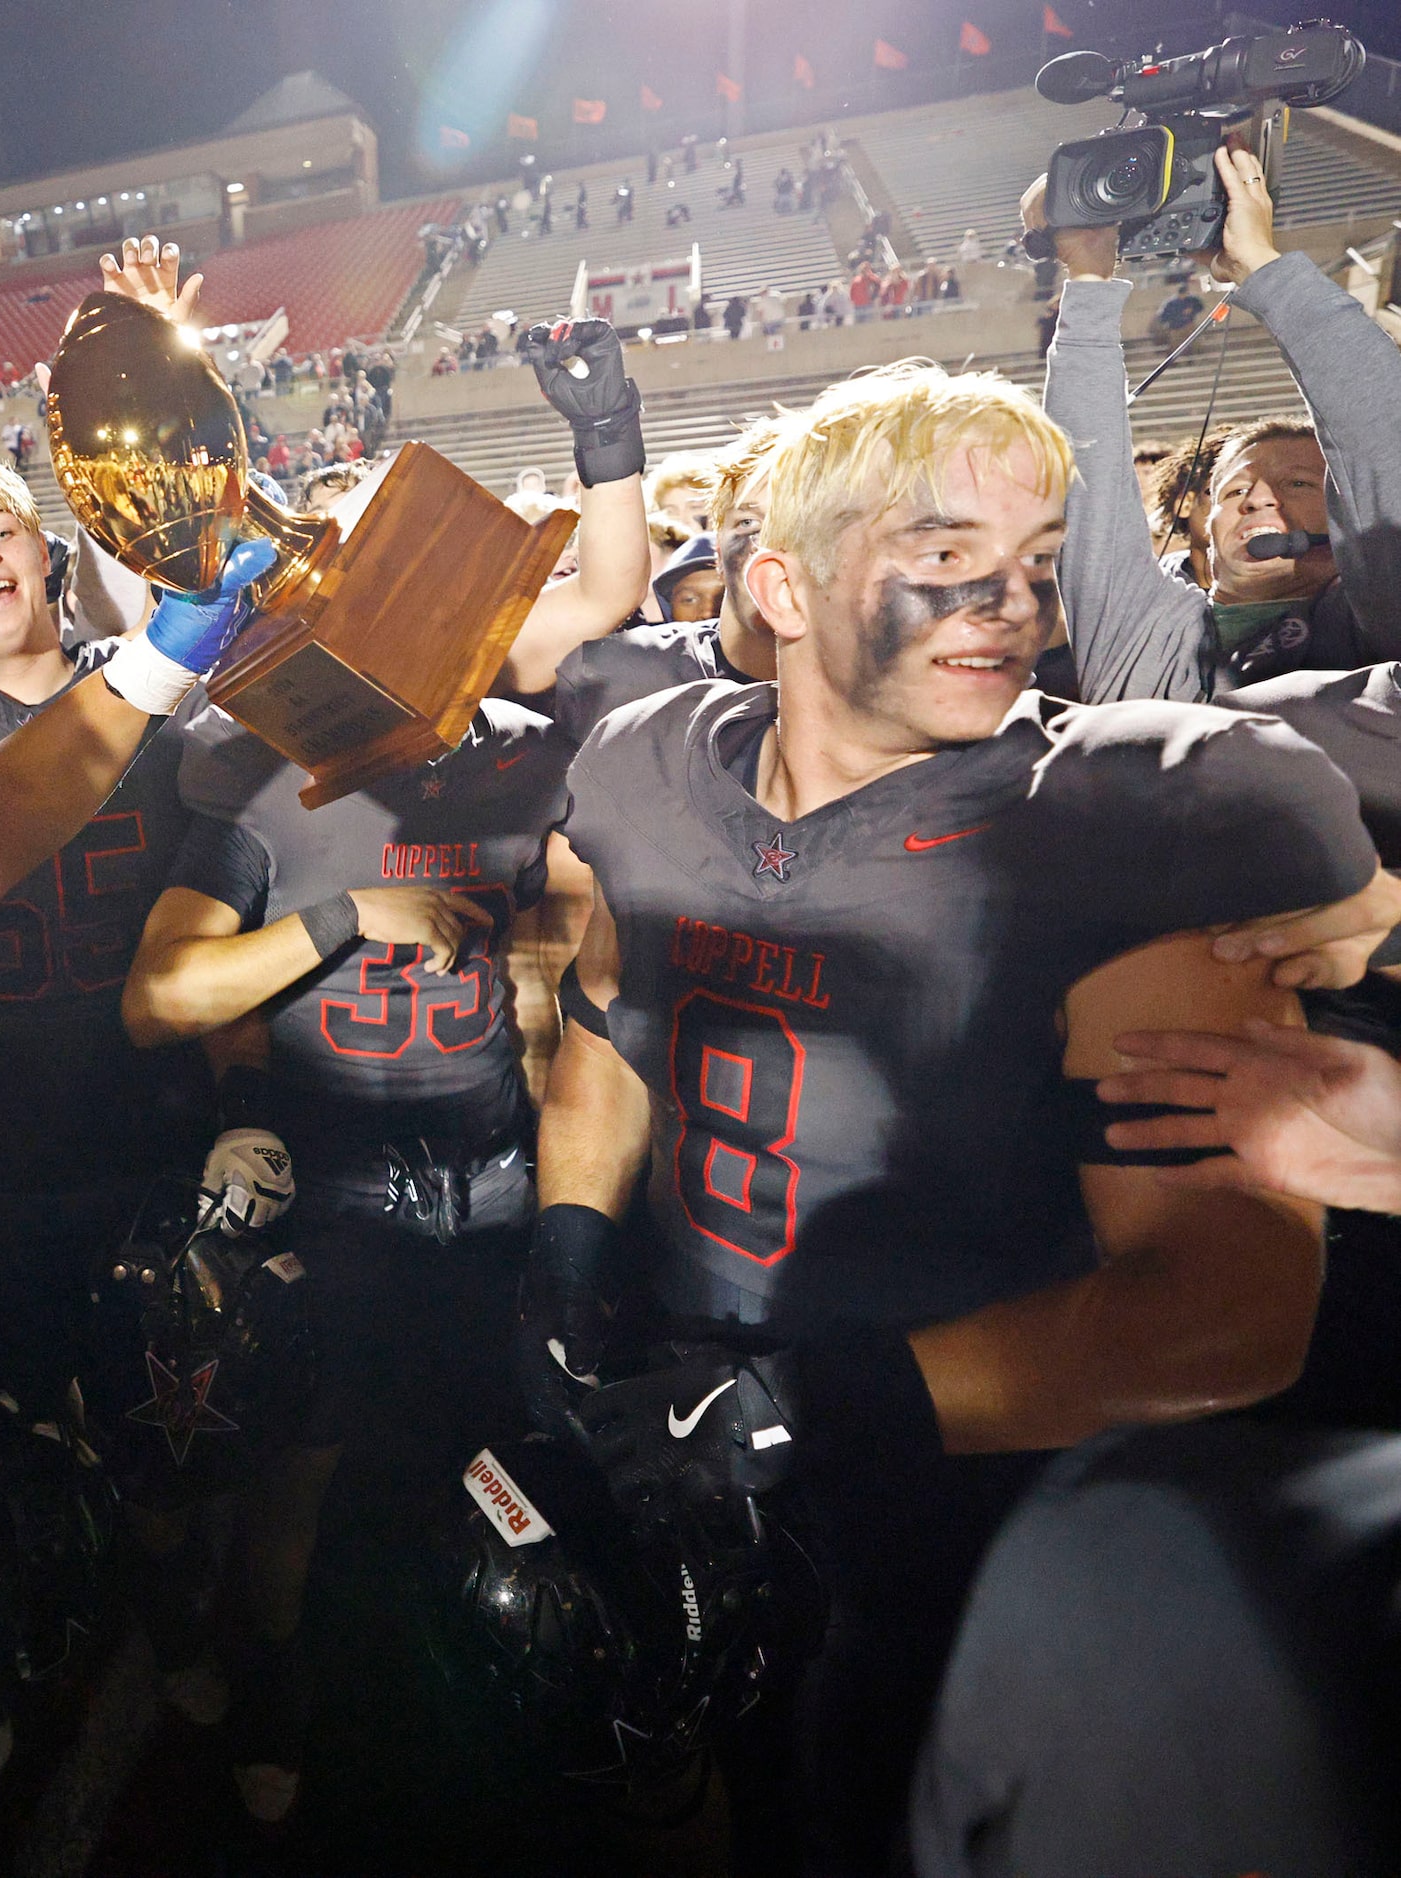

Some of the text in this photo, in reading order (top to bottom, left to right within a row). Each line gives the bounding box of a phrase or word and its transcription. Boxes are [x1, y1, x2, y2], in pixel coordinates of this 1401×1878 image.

[381, 843, 482, 879] COPPELL
[671, 916, 832, 1009] COPPELL
[669, 986, 807, 1269] 8
[470, 1460, 531, 1536] Riddell
